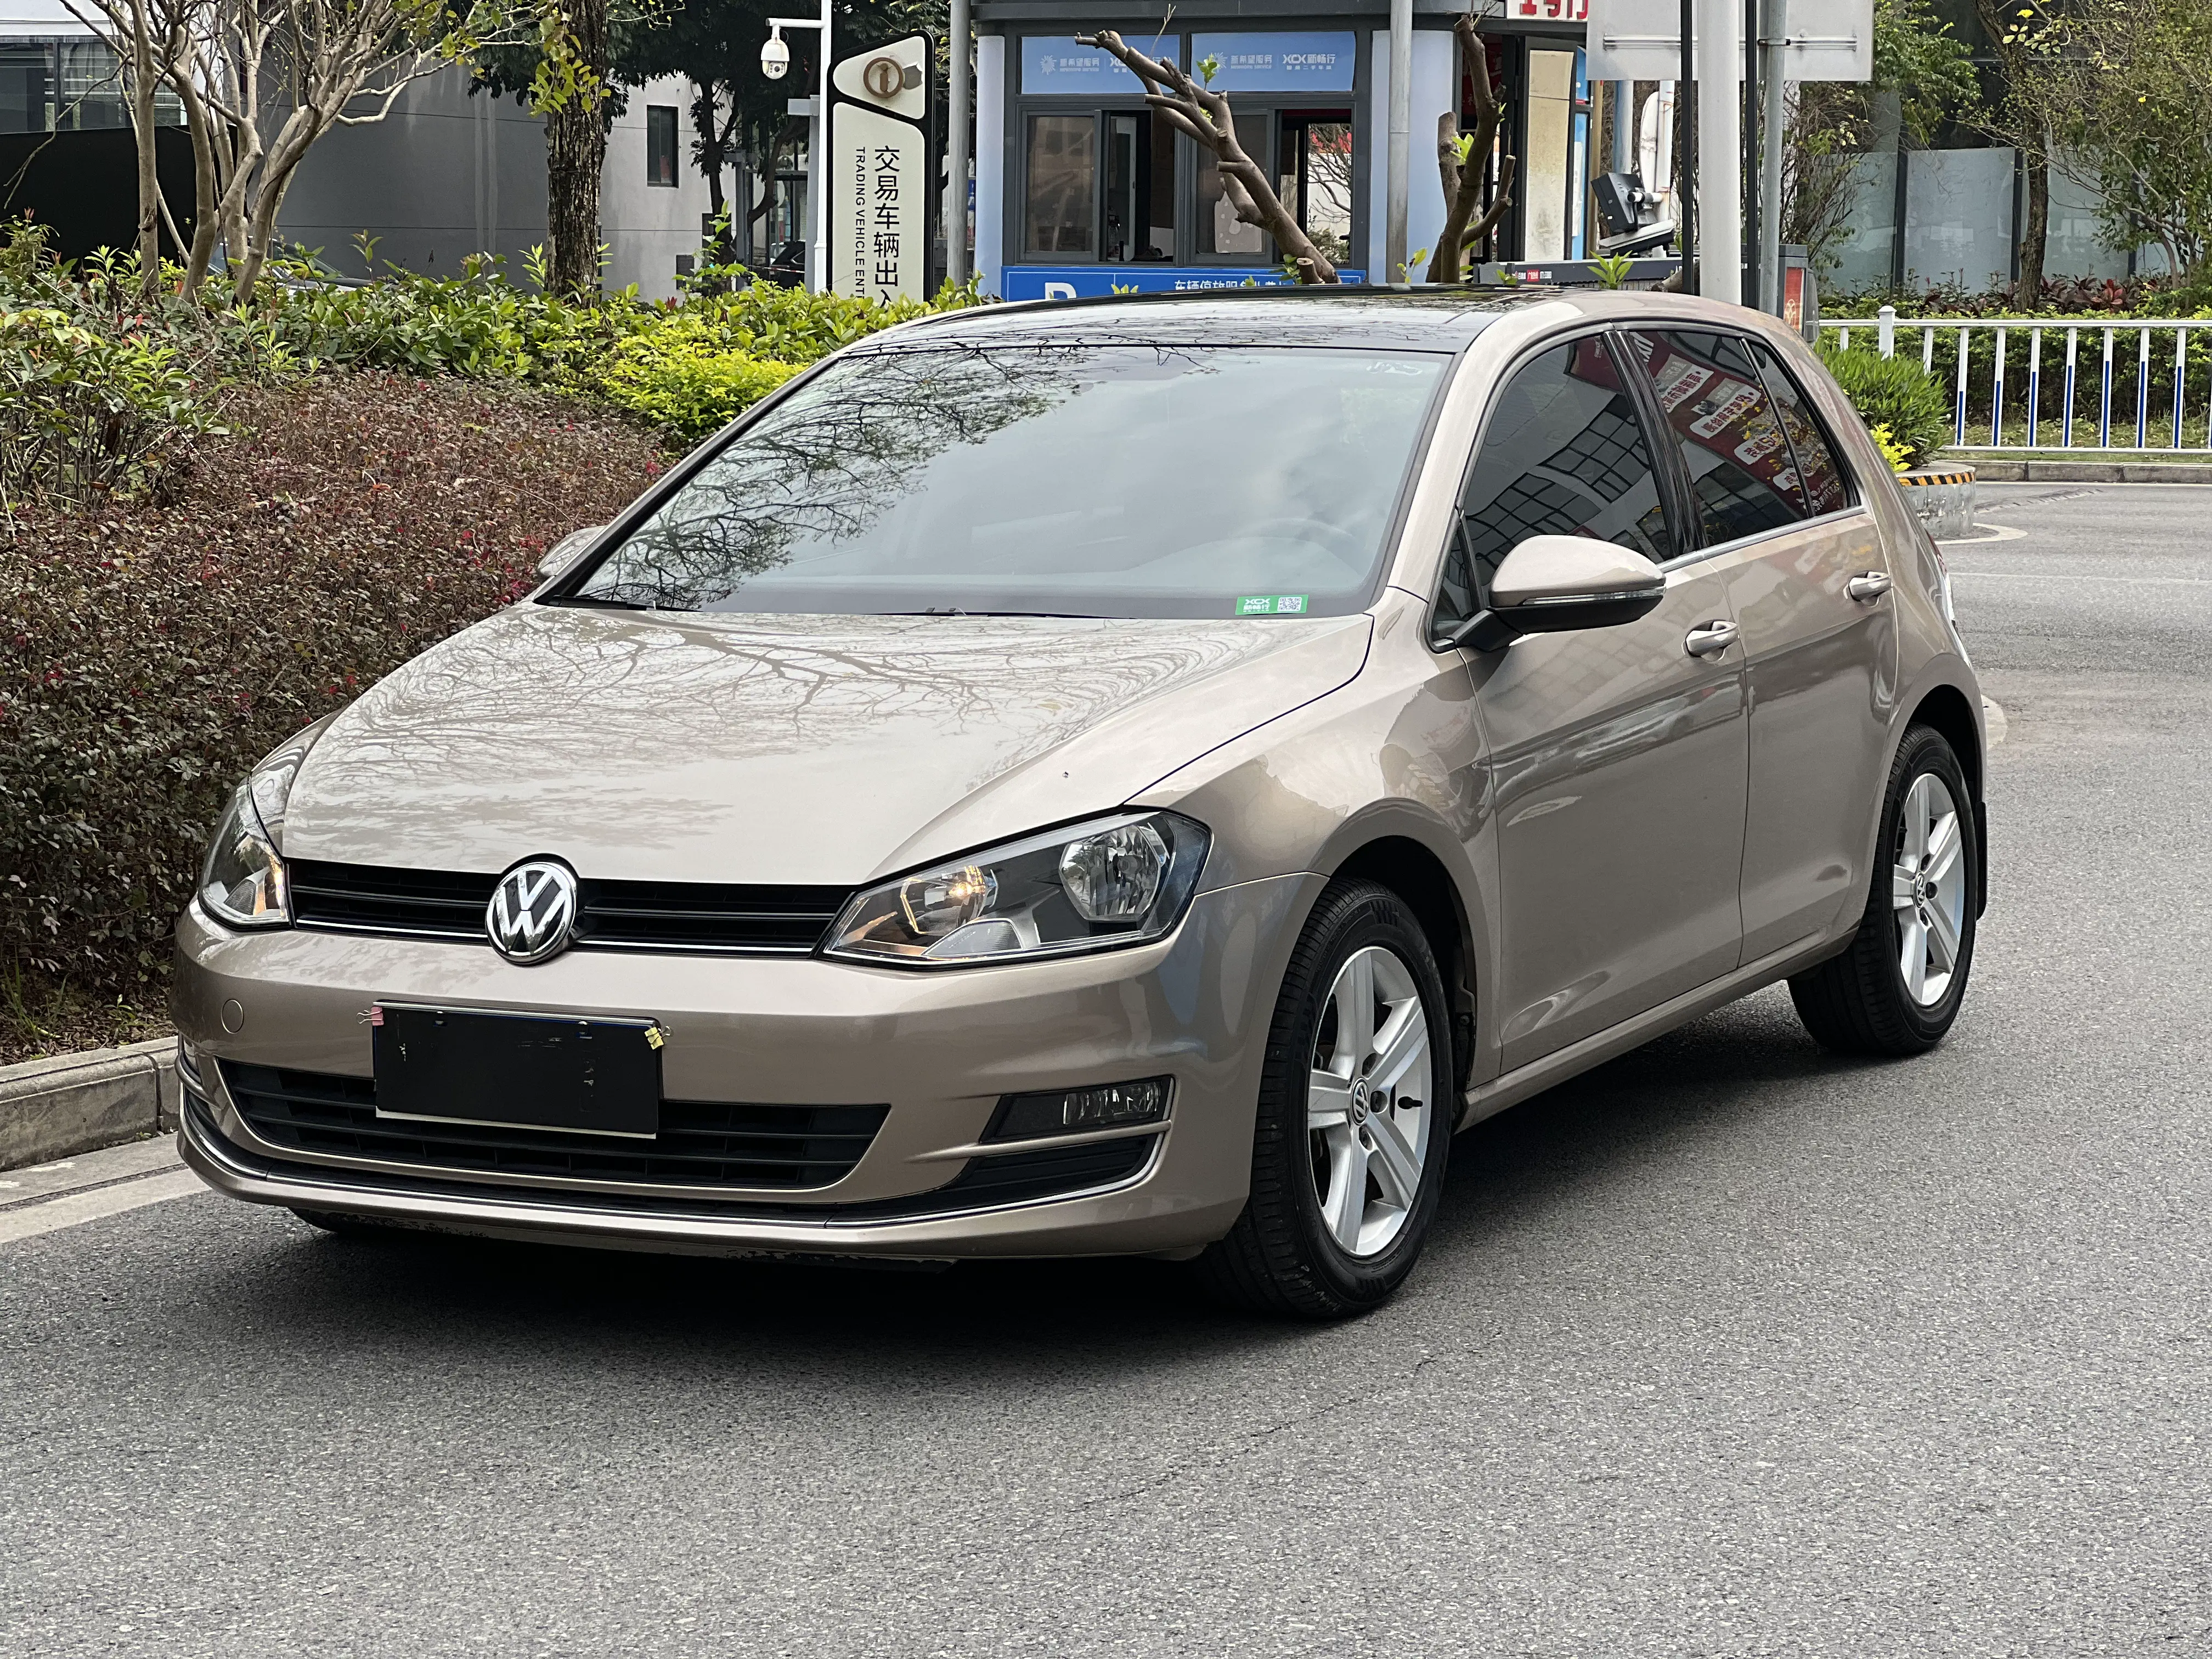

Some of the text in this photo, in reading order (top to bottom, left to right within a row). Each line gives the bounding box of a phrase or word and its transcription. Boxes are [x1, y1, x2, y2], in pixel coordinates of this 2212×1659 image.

[856, 146, 865, 206] TRADING
[855, 210, 865, 266] VEHICLE
[491, 866, 571, 956] VW
